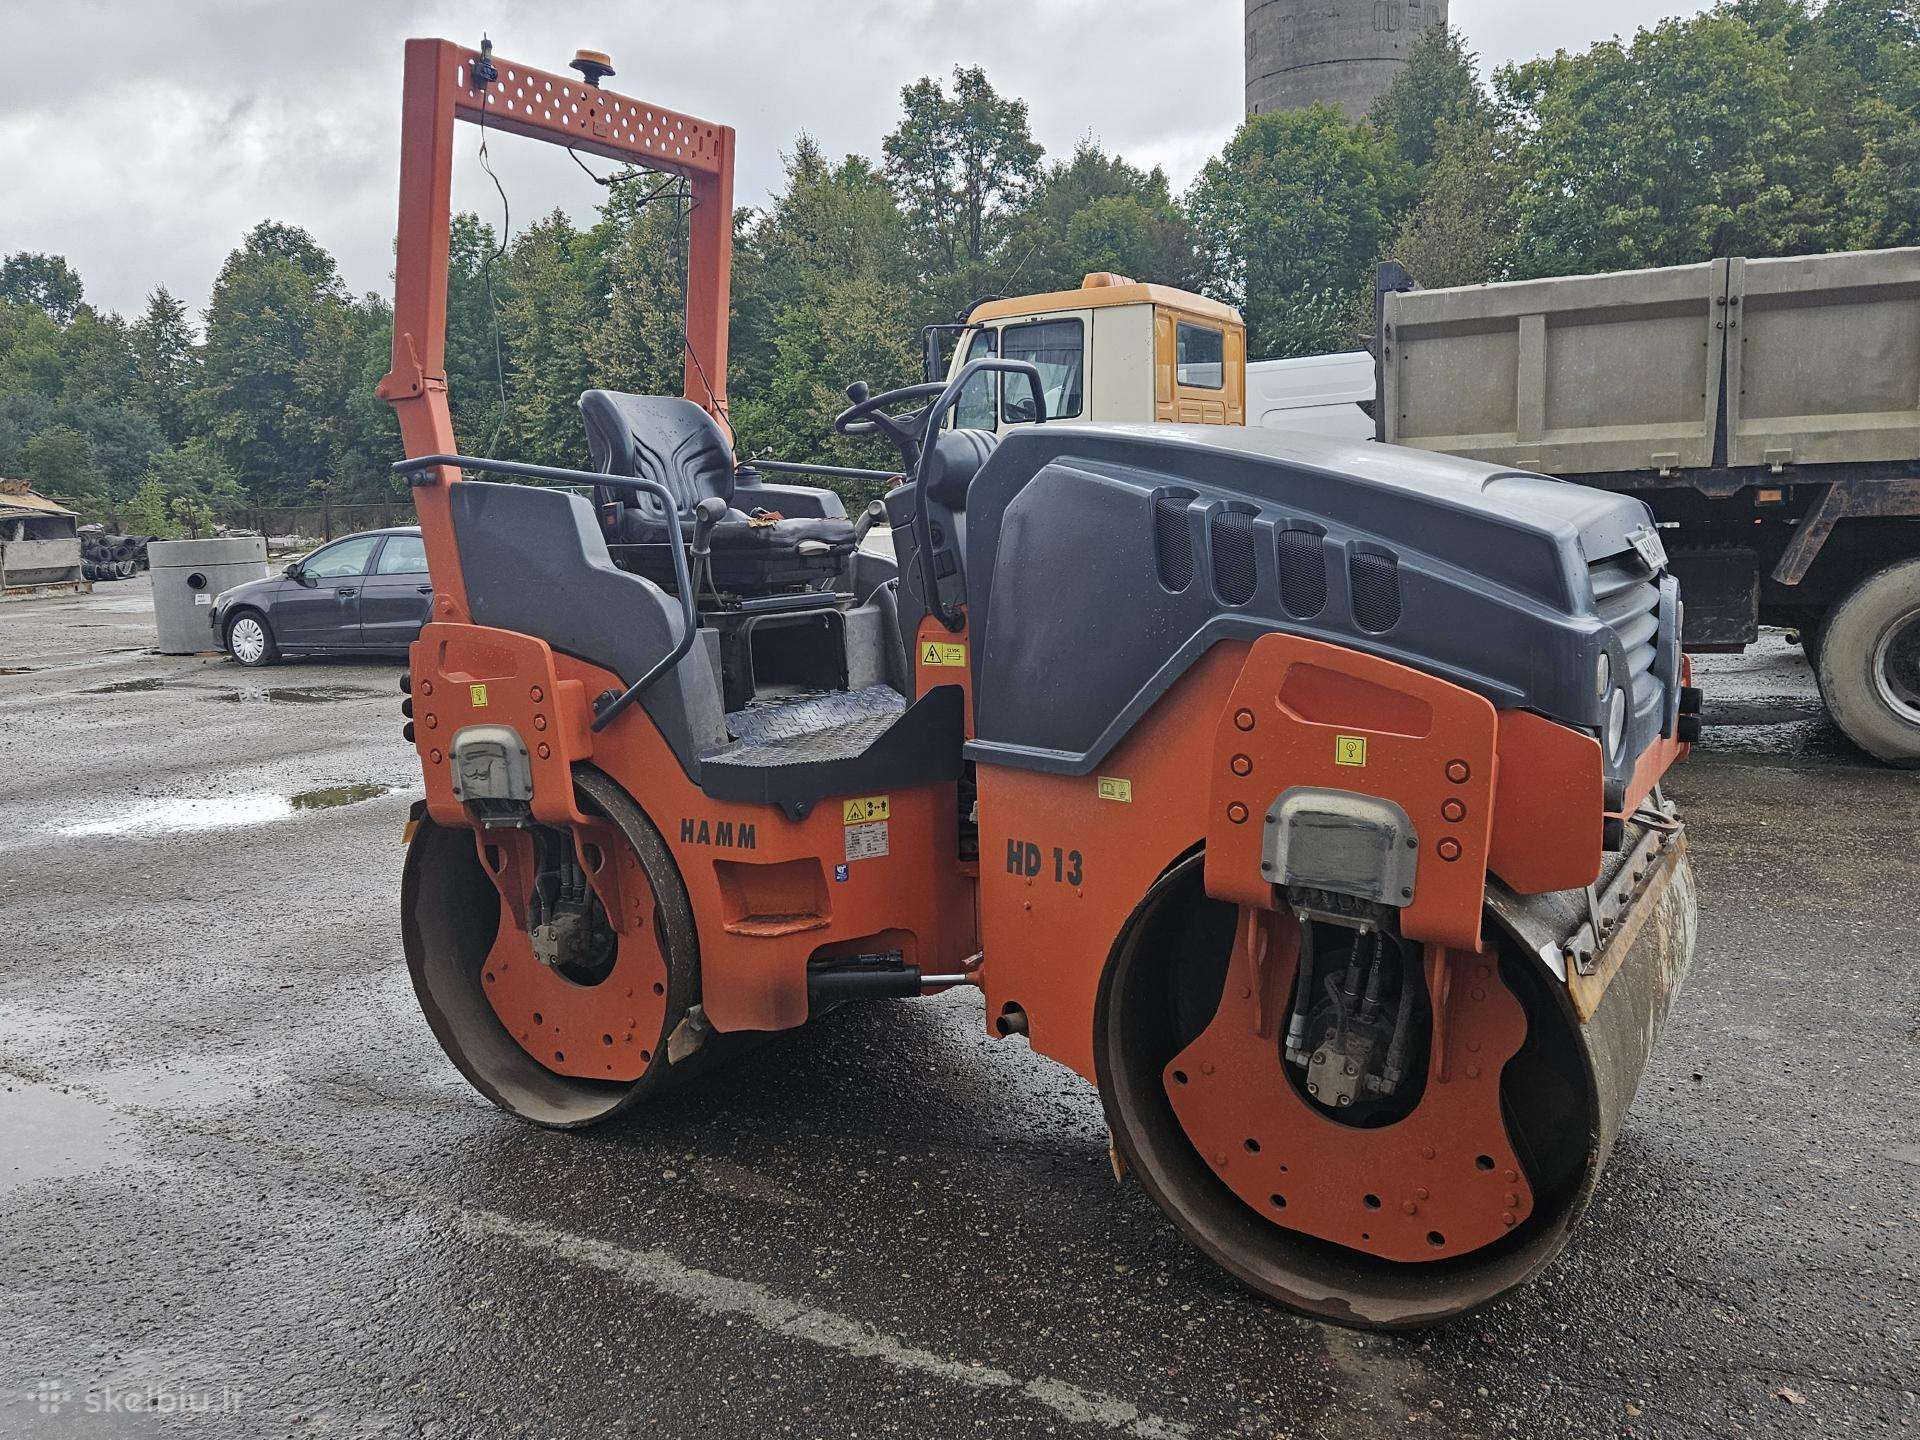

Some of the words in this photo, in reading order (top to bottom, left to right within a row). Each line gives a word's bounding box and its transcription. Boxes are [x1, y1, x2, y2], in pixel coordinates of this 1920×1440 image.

[680, 818, 756, 849] HAMM
[1006, 838, 1042, 877] HD
[1053, 847, 1083, 886] 13
